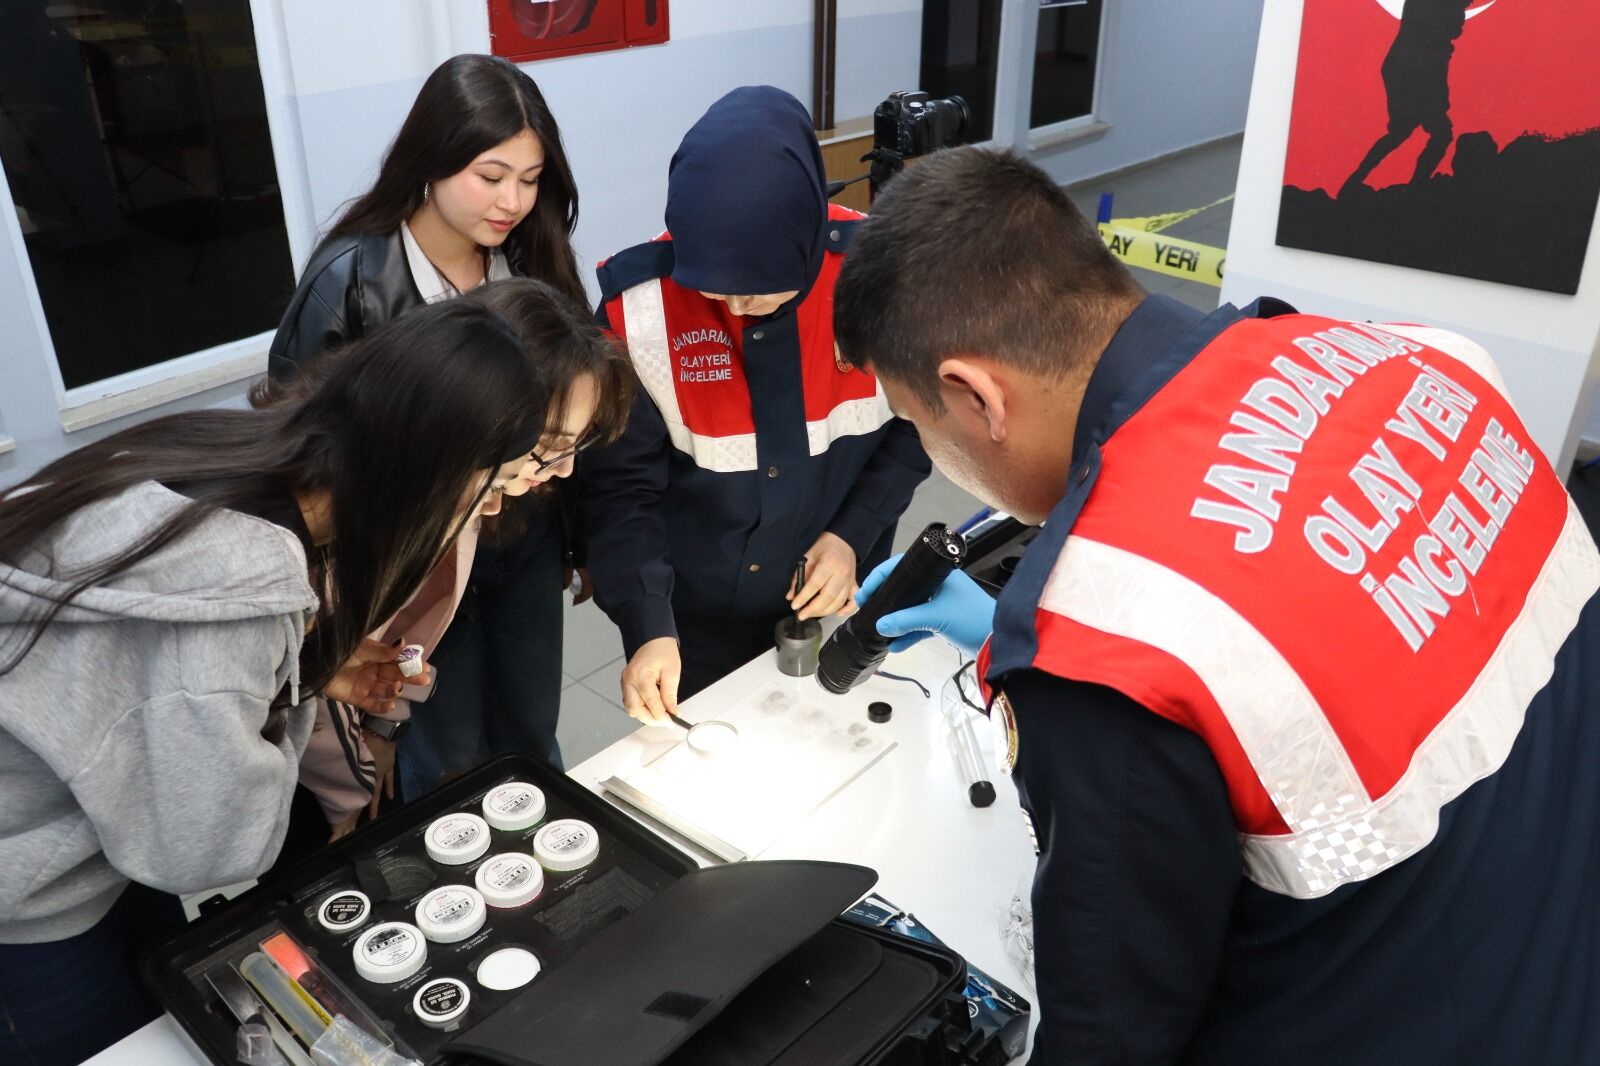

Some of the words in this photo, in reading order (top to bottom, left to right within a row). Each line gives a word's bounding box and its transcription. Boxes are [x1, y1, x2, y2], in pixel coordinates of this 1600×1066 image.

[673, 329, 732, 351] JANDARMA
[680, 355, 704, 367] OLAY
[705, 350, 731, 367] YERİ
[680, 368, 732, 382] İNCELEME
[1189, 323, 1424, 554] JANDARMA
[1303, 437, 1423, 575] OLAY
[1384, 356, 1478, 462] YERİ
[1359, 416, 1535, 654] İNCELEME
